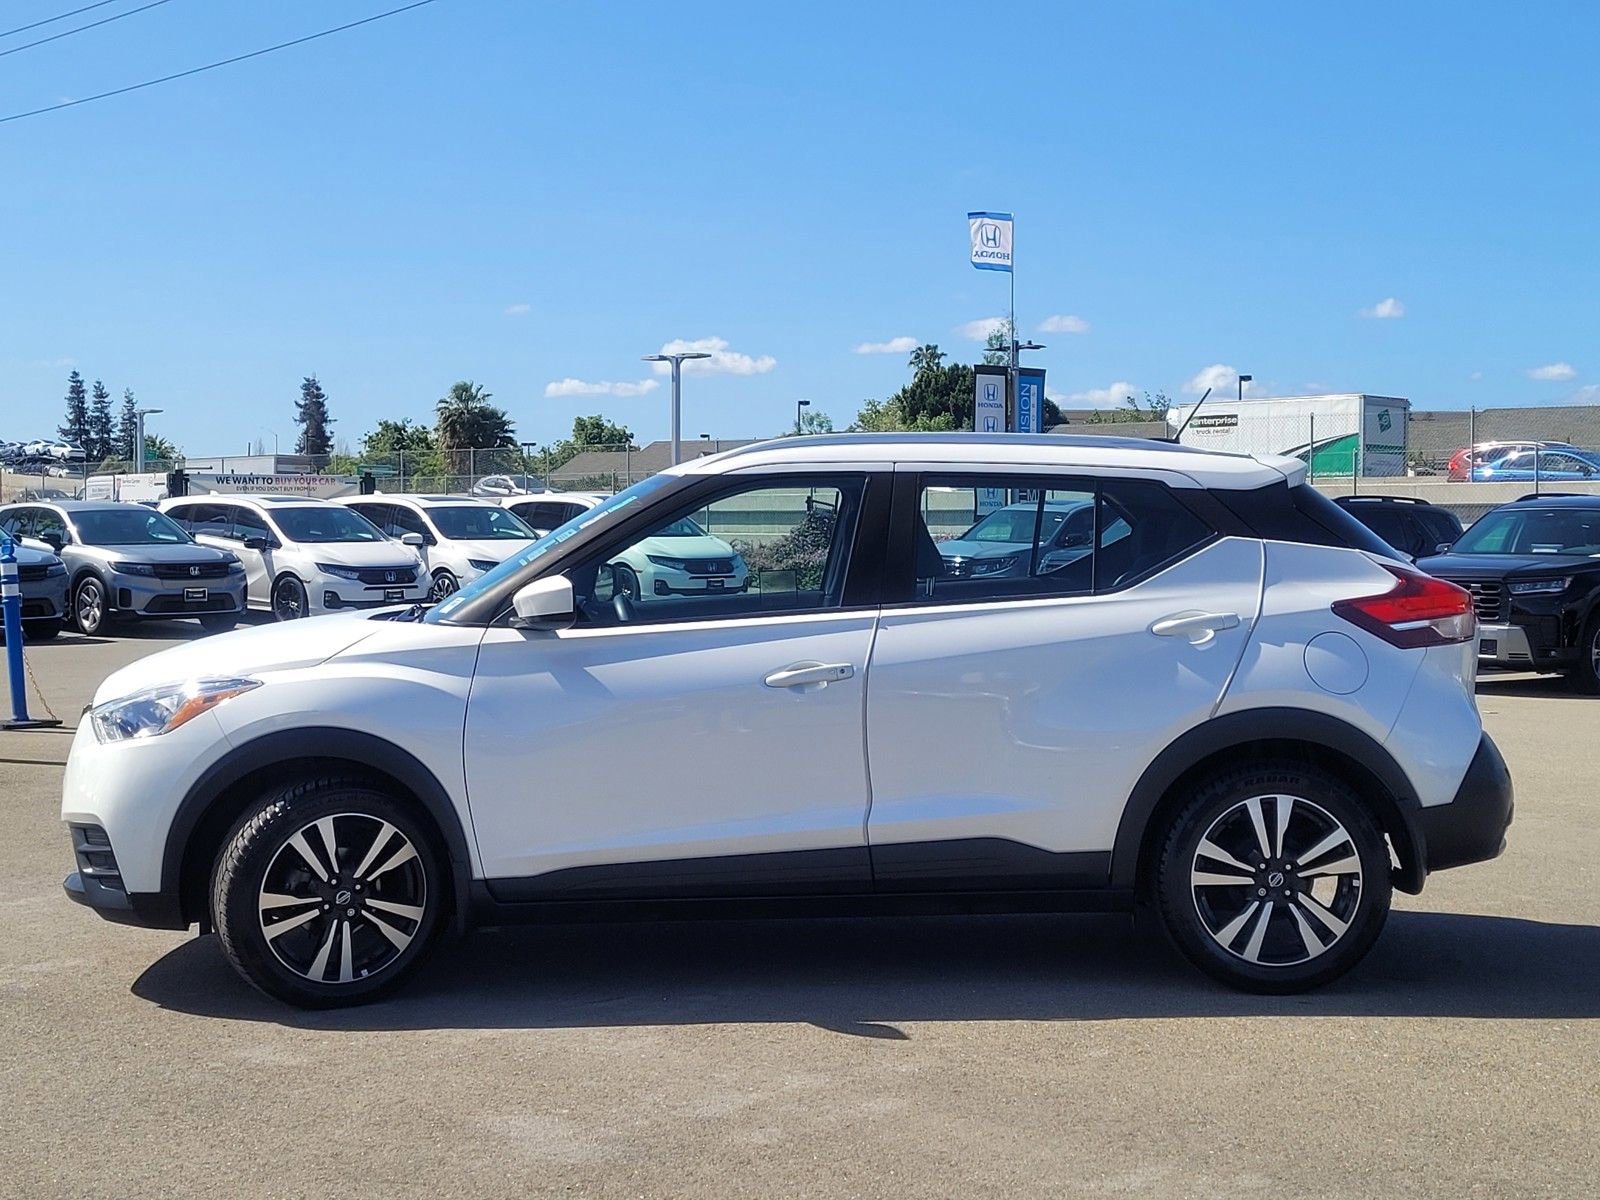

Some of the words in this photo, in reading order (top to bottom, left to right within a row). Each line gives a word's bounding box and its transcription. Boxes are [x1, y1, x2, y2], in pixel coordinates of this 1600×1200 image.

[1192, 416, 1238, 426] enterprise
[216, 476, 230, 485] WE
[232, 476, 260, 485] WANT
[262, 477, 273, 485] TO
[275, 477, 291, 485] BUY
